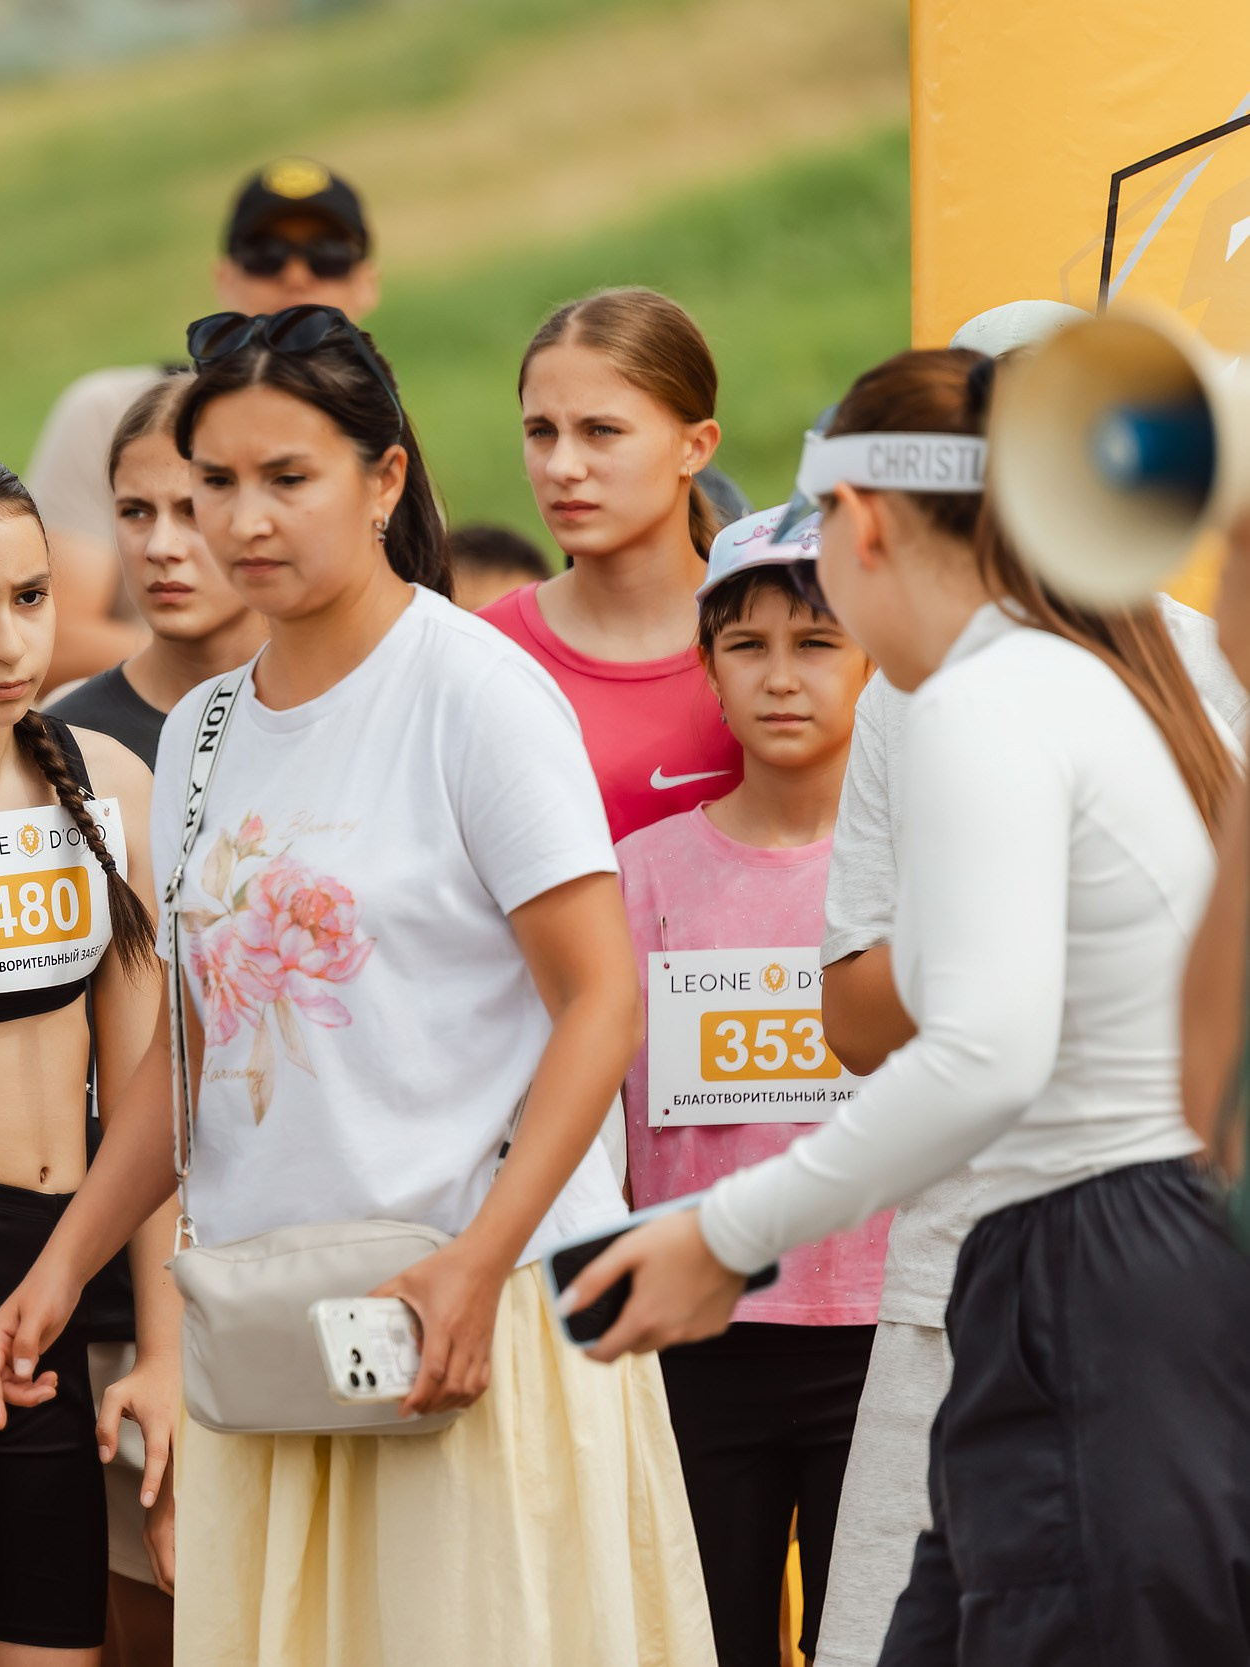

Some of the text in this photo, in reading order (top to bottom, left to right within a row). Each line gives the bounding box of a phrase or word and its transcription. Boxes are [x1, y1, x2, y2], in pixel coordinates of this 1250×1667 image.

[867, 441, 981, 482] CHRISTI
[199, 686, 234, 753] NOT
[670, 972, 751, 994] LEONE
[714, 1017, 827, 1073] 353
[673, 1088, 860, 1106] БЛАГОТВОРИТЕЛЬНЫЙ ЗАБ
